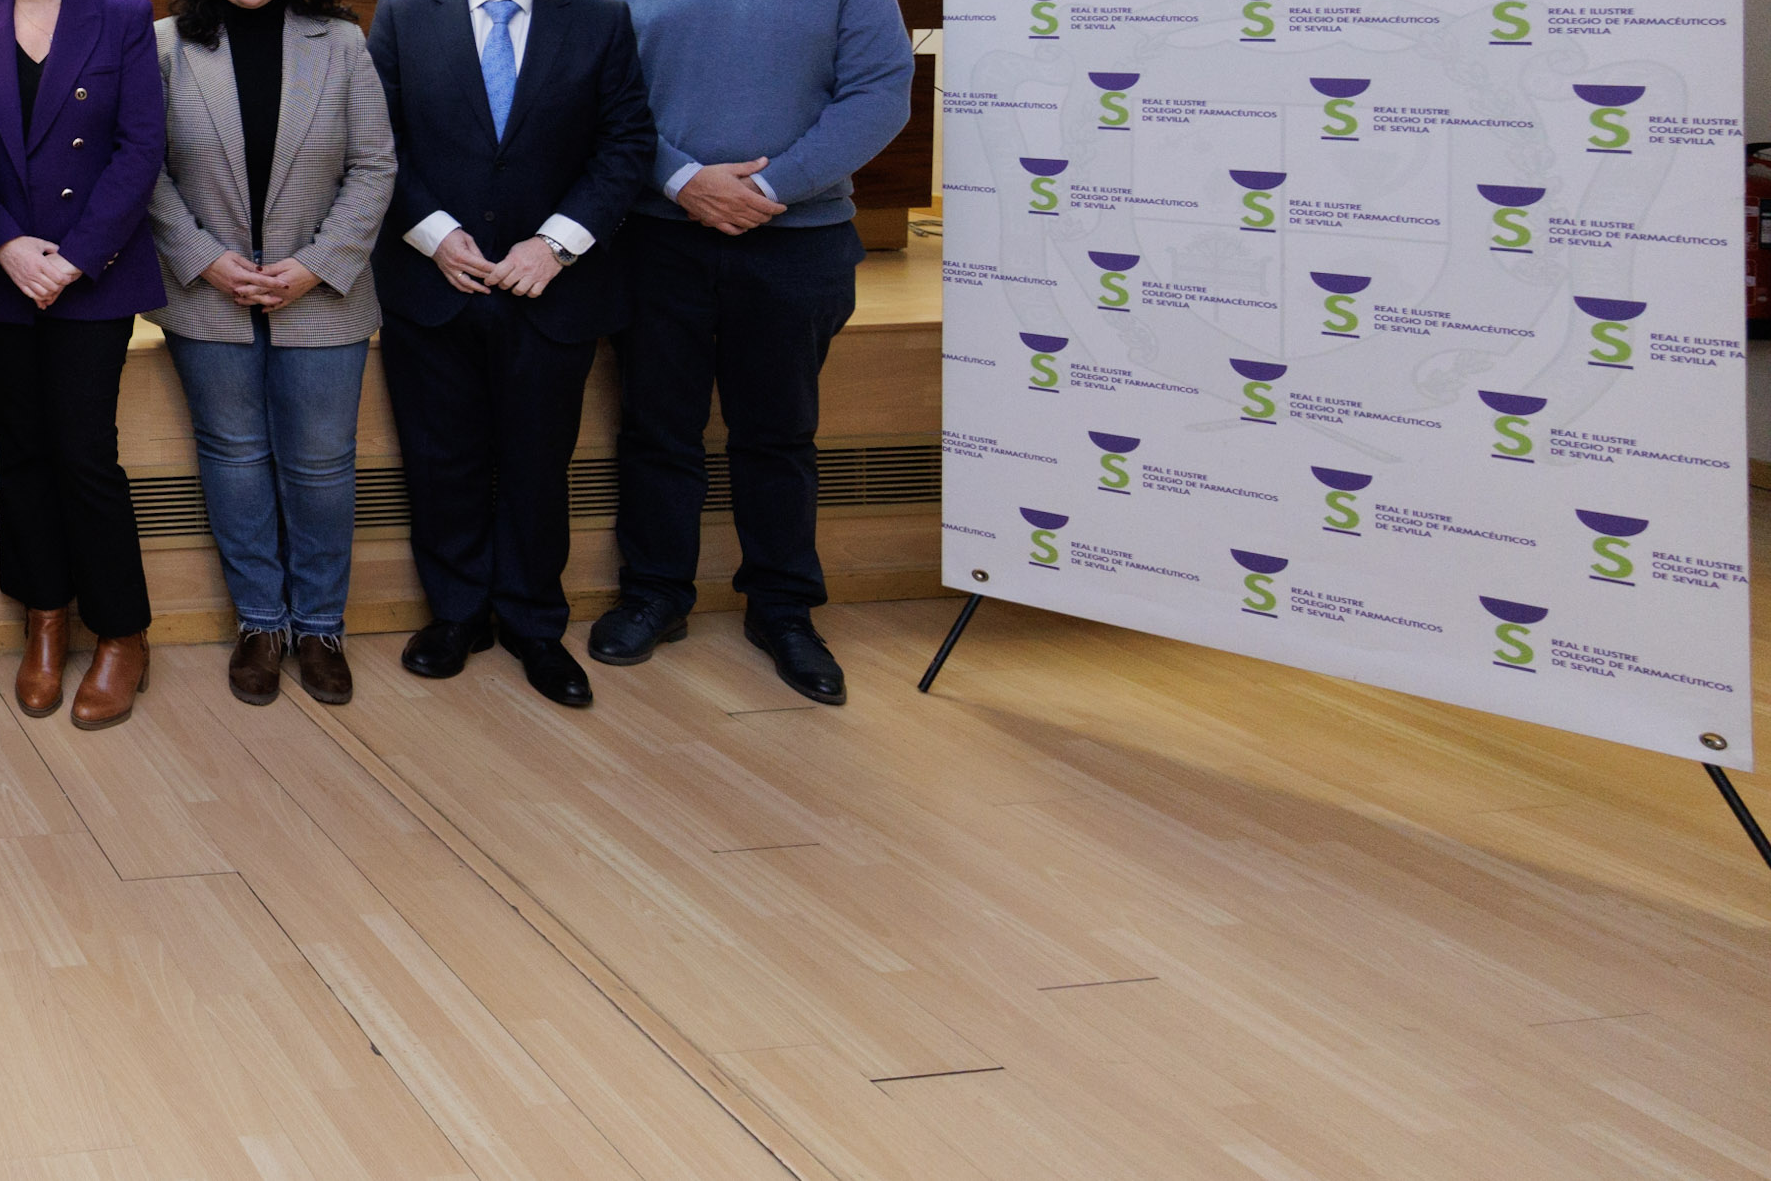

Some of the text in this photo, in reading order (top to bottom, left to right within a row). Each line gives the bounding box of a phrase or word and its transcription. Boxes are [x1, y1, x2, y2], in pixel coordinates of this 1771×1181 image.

[1623, 16, 1728, 25] FARMACÉUTICOS
[1410, 107, 1449, 115] ILUSTRE
[1373, 115, 1421, 123] COLEGIO
[1440, 116, 1533, 128] FARMACÉUTICOS
[1390, 125, 1429, 133] SEVILLA
[1100, 186, 1131, 194] ILUSTRE
[1070, 192, 1108, 201] COLEGIO
[1124, 195, 1198, 207] FARMACÉUTICOS
[1083, 201, 1115, 209] SEVILLA
[1548, 217, 1576, 225] REAL
[1590, 220, 1634, 229] ILUSTRE
[1548, 226, 1729, 246] COLEGIO DE FARMACÉUTICOS
[1549, 236, 1612, 247] DE SEVILLA
[1374, 305, 1398, 313] REAL
[1411, 308, 1450, 318] ILUSTRE
[1374, 313, 1534, 337] COLEGIO DE FARMACÉUTICOS
[1390, 324, 1430, 335] SEVILLA
[1375, 503, 1399, 513] REAL
[1412, 509, 1451, 522] ILUSTRE
[1375, 521, 1431, 537] DE SEVILLA
[1375, 512, 1536, 547] COLEGIO DE FARMACÉUTICOS
[1071, 541, 1090, 550] REAL
[1101, 547, 1132, 559] ILUSTRE
[1071, 557, 1116, 572] DE SEVILLA
[1071, 549, 1199, 582] COLEGIO DE FARMACÉUTICOS
[1551, 638, 1579, 650] REAL
[1593, 647, 1637, 662] ILUSTRE
[1551, 658, 1615, 678] DE SEVILLA
[1551, 648, 1733, 693] COLEGIO DE FARMACÉUTICOS
